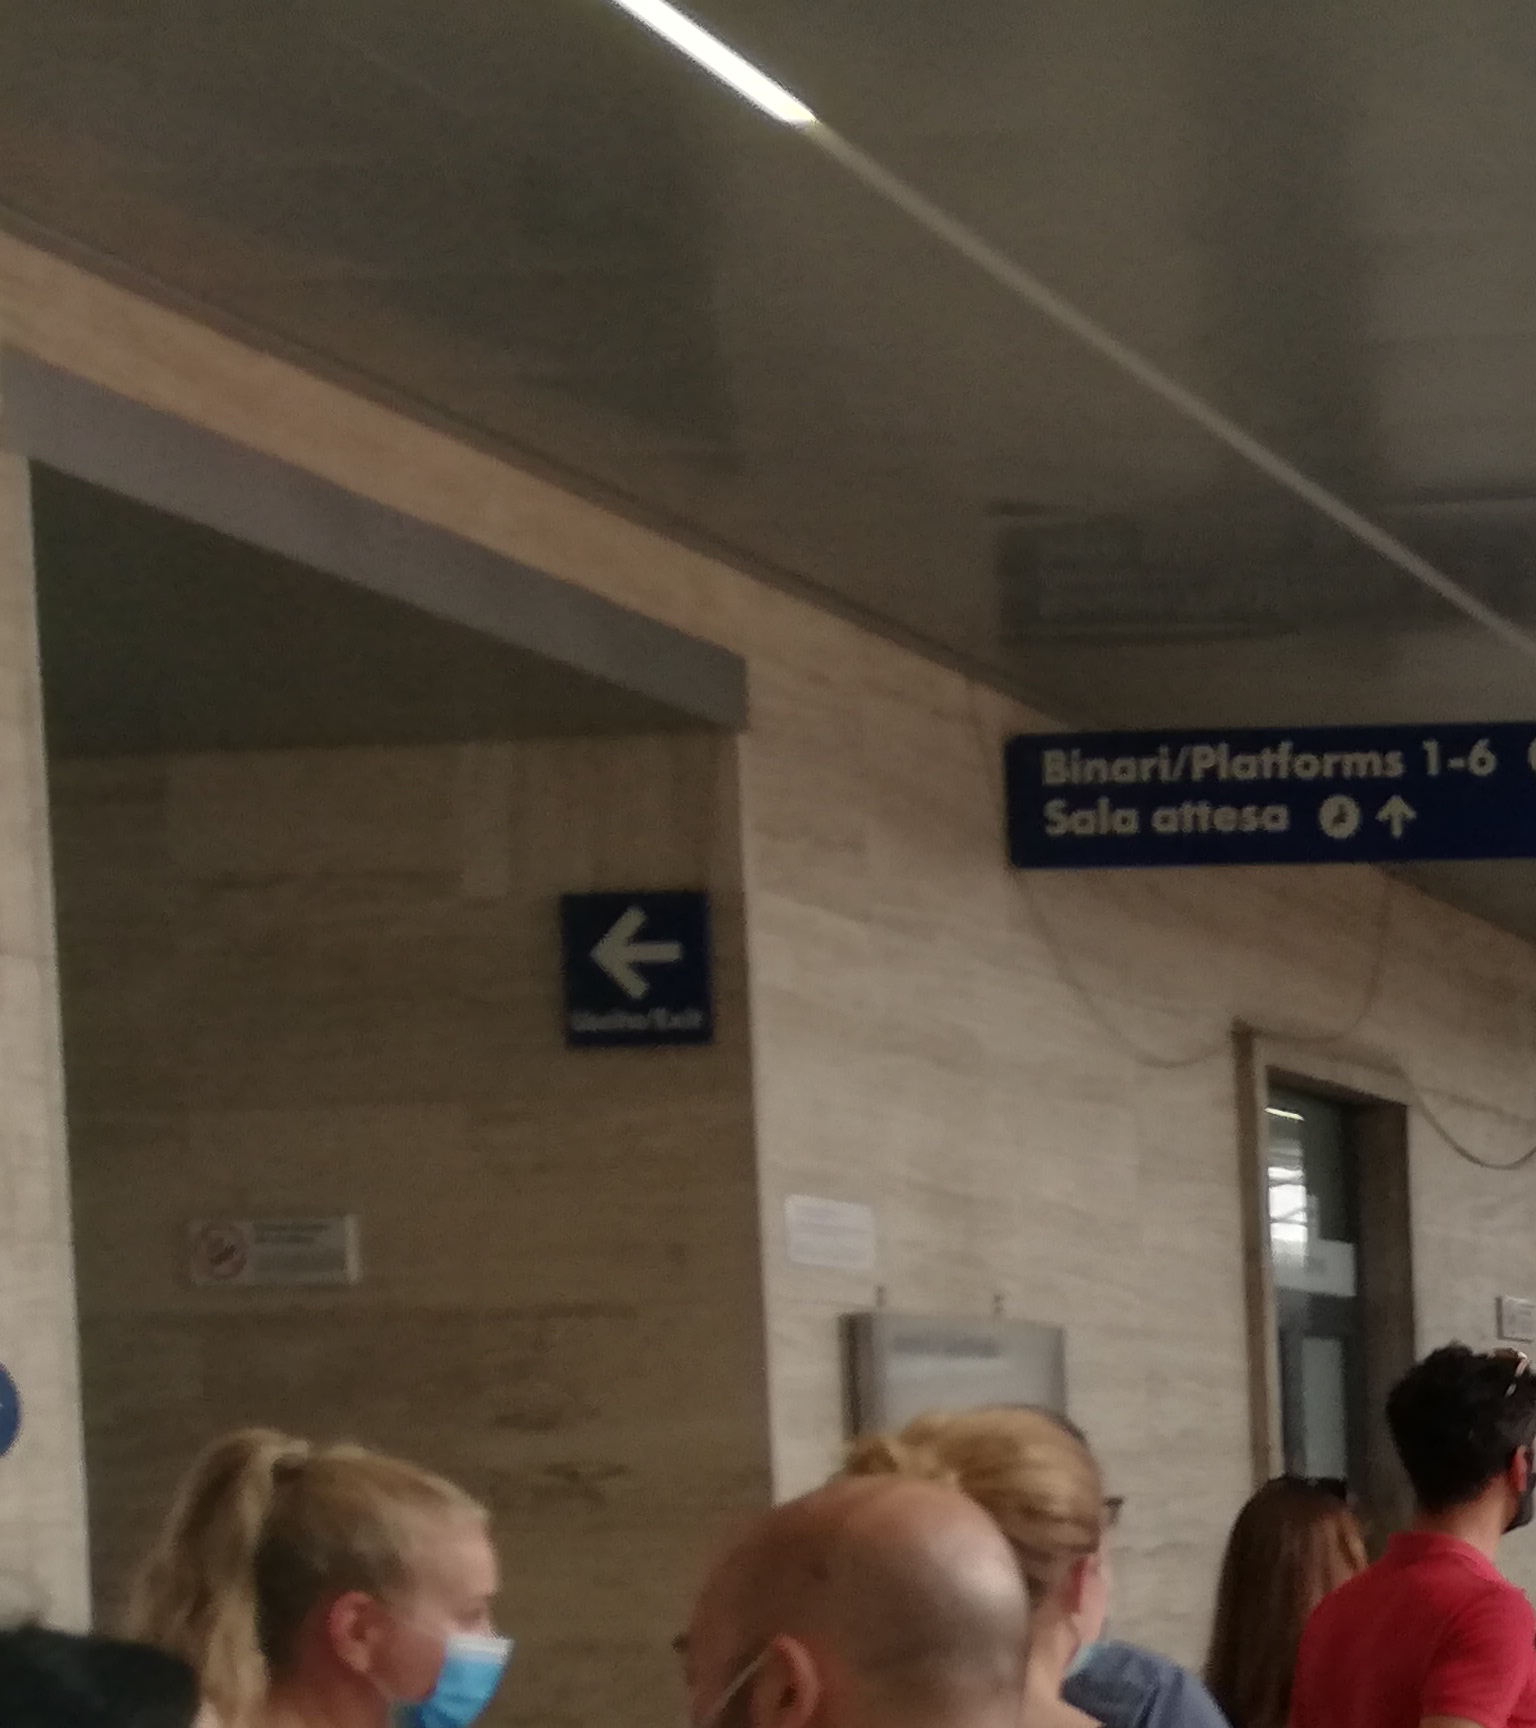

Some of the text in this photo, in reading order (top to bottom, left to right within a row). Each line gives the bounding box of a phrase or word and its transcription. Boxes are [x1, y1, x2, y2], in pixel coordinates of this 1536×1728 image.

[1040, 737, 1497, 786] Binari/Platforms 1-6
[1042, 797, 1292, 837] Sala attesa
